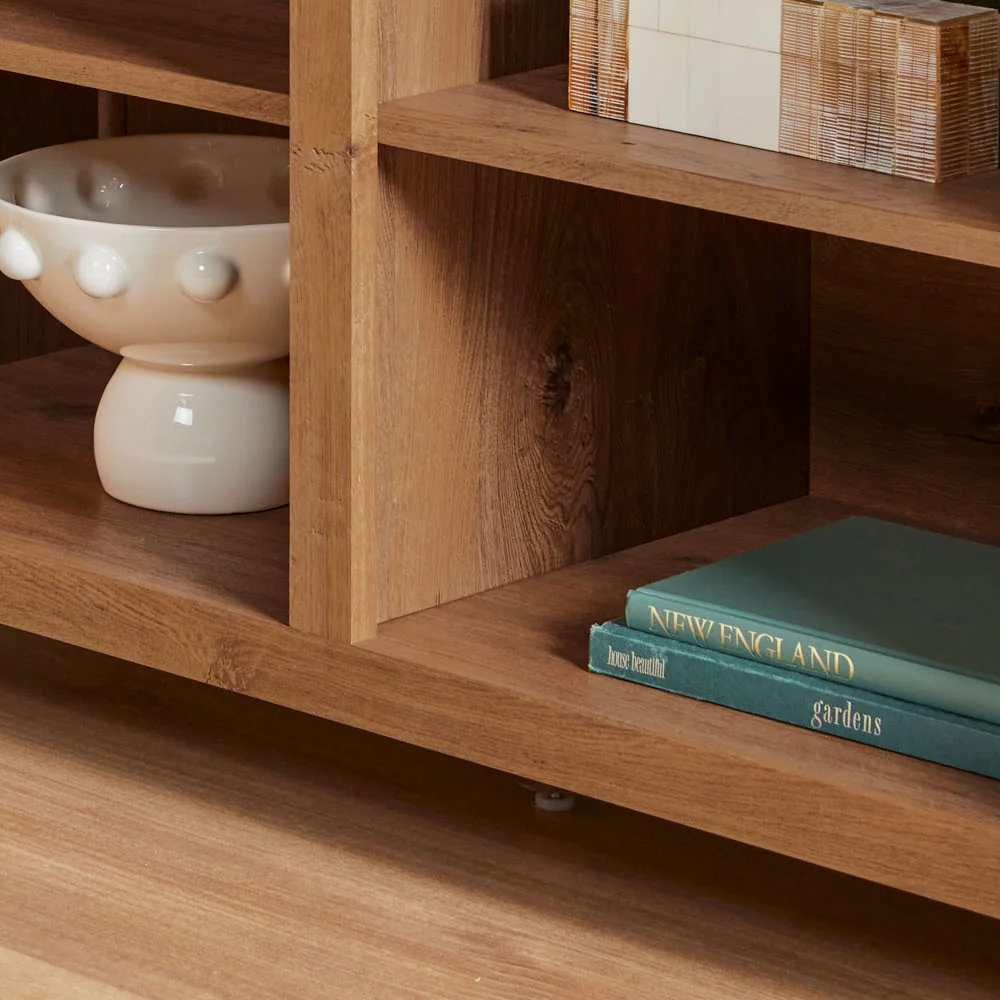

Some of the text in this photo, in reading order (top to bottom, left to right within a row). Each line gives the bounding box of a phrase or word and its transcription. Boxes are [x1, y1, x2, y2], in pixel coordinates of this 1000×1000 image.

[648, 605, 855, 680] NEW ENGLAND
[607, 645, 666, 679] house beautiful
[810, 700, 882, 737] gardens
